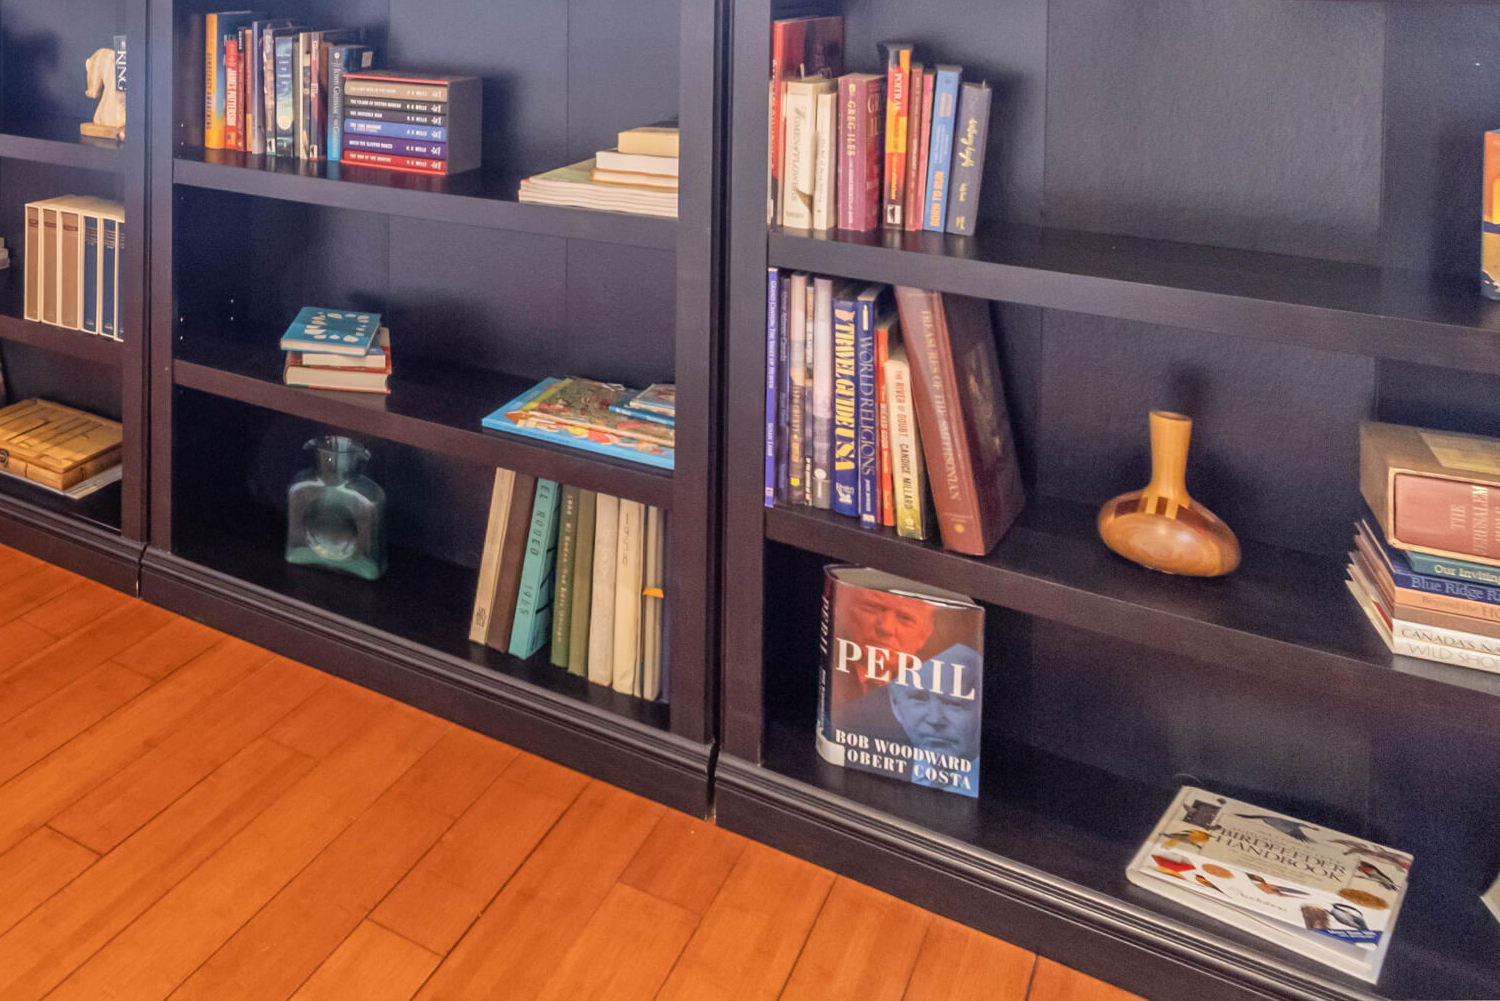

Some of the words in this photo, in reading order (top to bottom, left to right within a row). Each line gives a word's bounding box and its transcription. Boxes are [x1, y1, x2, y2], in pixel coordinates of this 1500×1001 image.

[227, 68, 237, 90] JAMES
[226, 90, 237, 126] PATTERSON
[847, 101, 856, 130] GREG
[846, 132, 856, 157] ILES
[931, 191, 943, 202] TO
[933, 171, 944, 190] RUN
[930, 203, 941, 227] BORN
[835, 323, 855, 377] TRAVEL
[921, 311, 938, 373] TREASURES
[859, 336, 873, 397] WORLD
[895, 382, 906, 403] RIVER
[931, 376, 941, 390] OF
[835, 378, 855, 428] GUIDE
[934, 394, 945, 416] THE
[860, 398, 875, 476] RELIGIONS
[897, 414, 907, 437] DOUBT
[835, 428, 855, 471] USA
[899, 444, 911, 475] CANDICE
[938, 420, 960, 502] SMITHSONIAN
[539, 485, 550, 499] EL
[902, 477, 912, 510] MILLARD
[530, 510, 546, 556] RODEO
[1450, 504, 1466, 530] THE
[1471, 485, 1489, 556] JERUSALEM
[1411, 575, 1442, 591] Blue
[1445, 580, 1484, 600] Ridge
[1434, 564, 1456, 576] Our
[1459, 567, 1500, 585] Inviting
[1407, 642, 1453, 660] WILD
[835, 637, 976, 701] PERIL
[835, 728, 870, 750] BOB
[874, 737, 972, 773] WOODWARD
[846, 748, 908, 774] OBERT
[913, 763, 972, 791] COSTA
[1214, 835, 1342, 883] HANDBOOK
[1219, 827, 1347, 876] BIRDFEEDER
